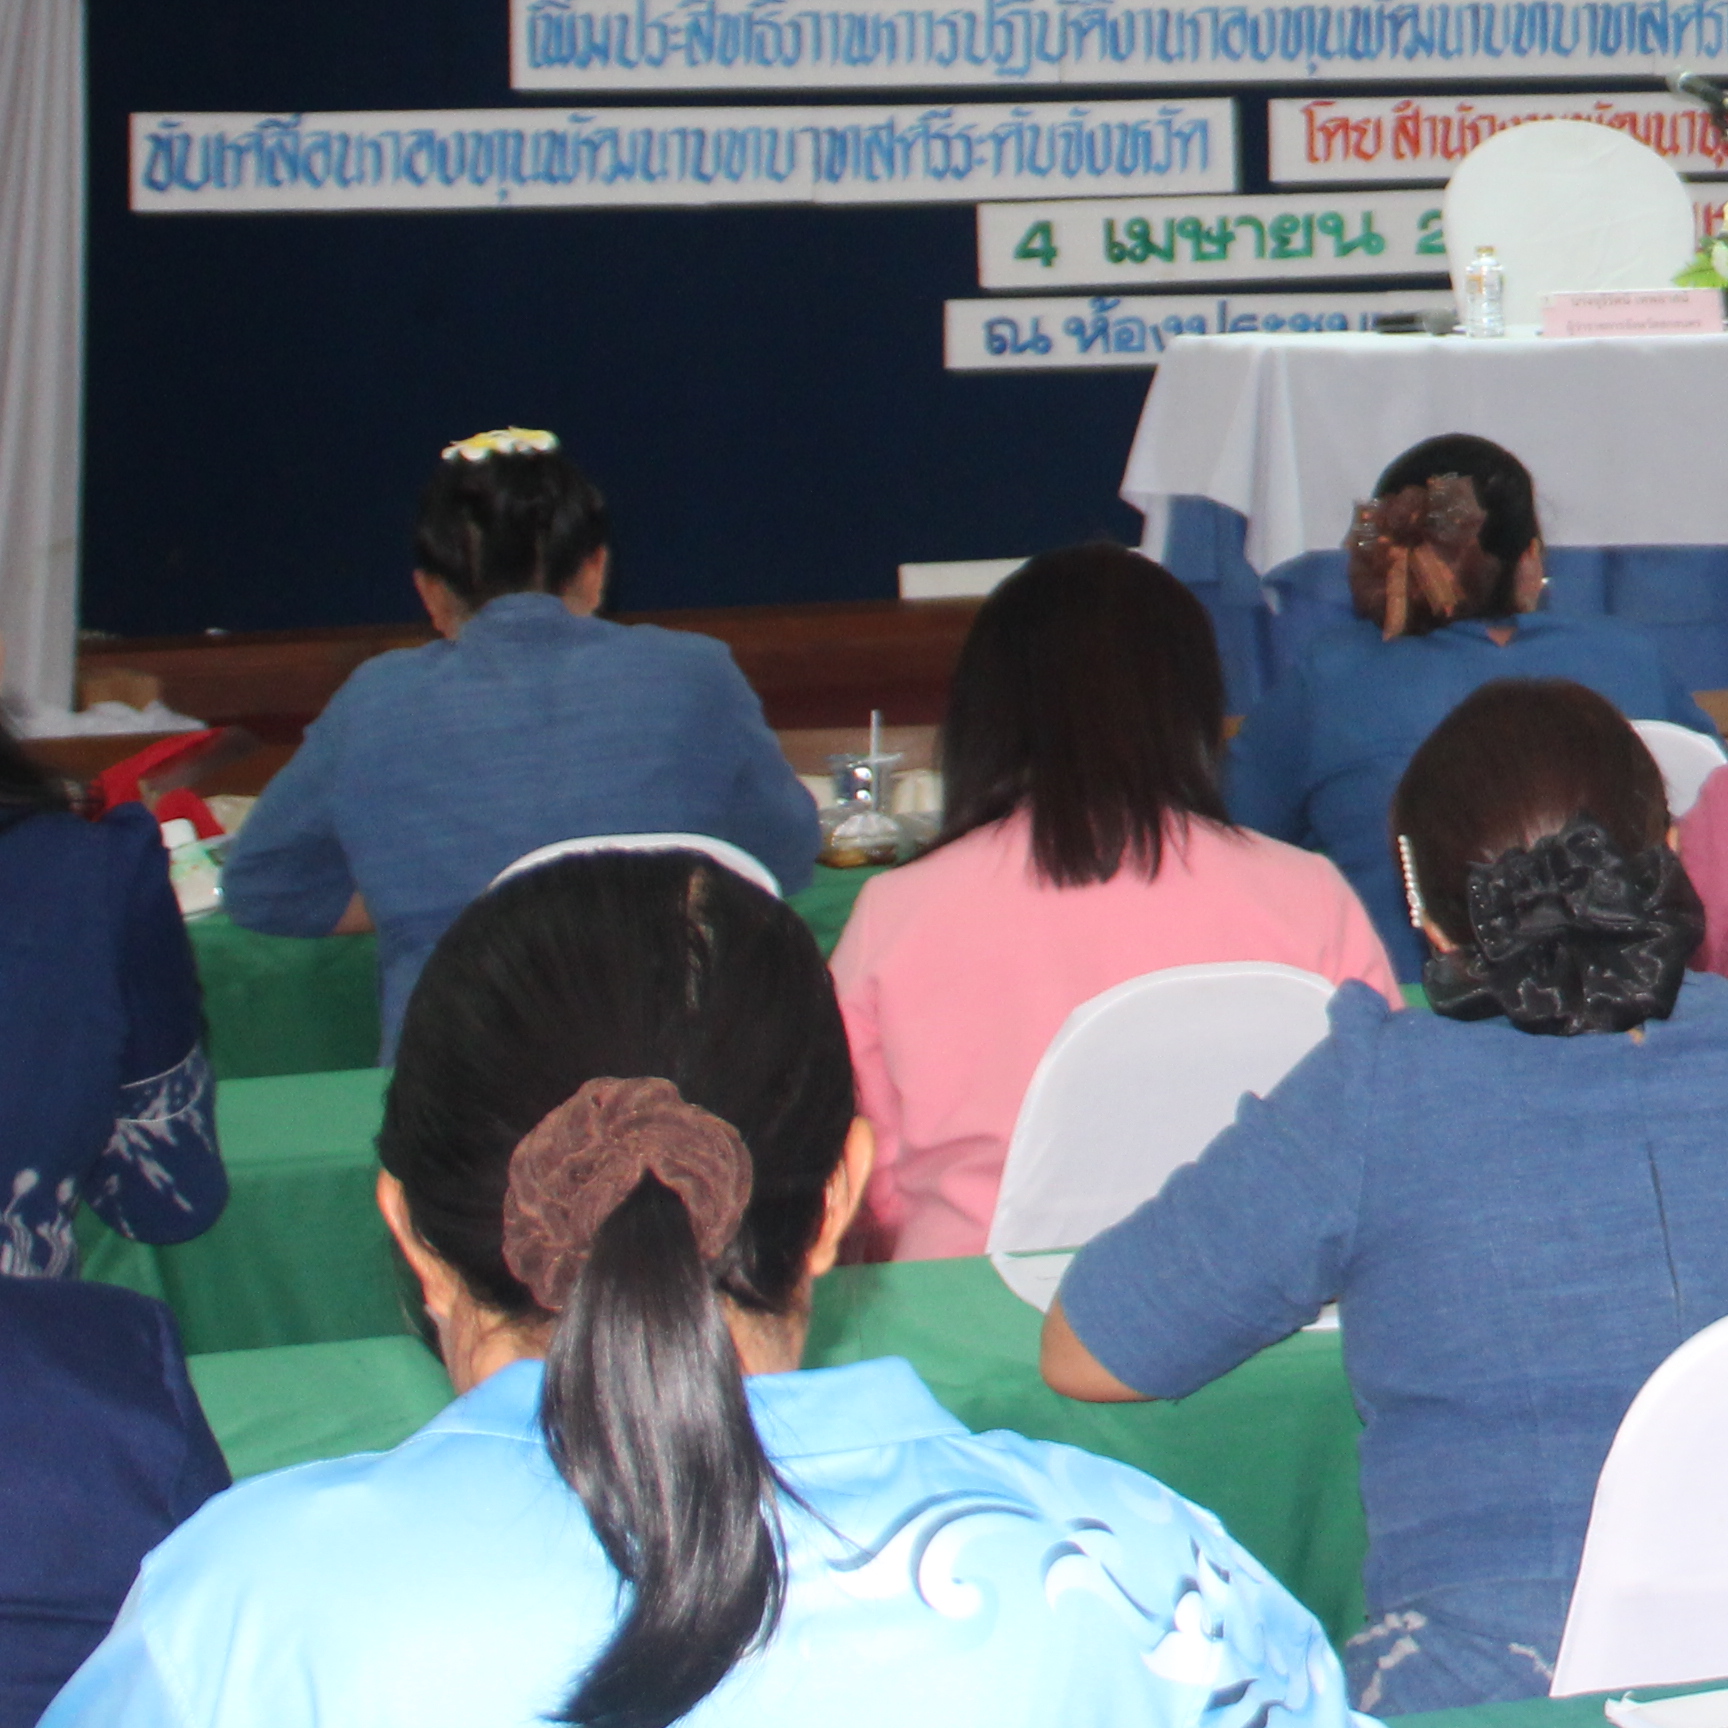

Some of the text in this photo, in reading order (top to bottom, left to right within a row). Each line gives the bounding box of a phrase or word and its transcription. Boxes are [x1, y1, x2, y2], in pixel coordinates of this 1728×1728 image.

[1301, 100, 1386, 164] โดย
[1013, 221, 1058, 268] 4
[1103, 210, 1387, 265] เมษายน
[984, 317, 1053, 356] ณ
